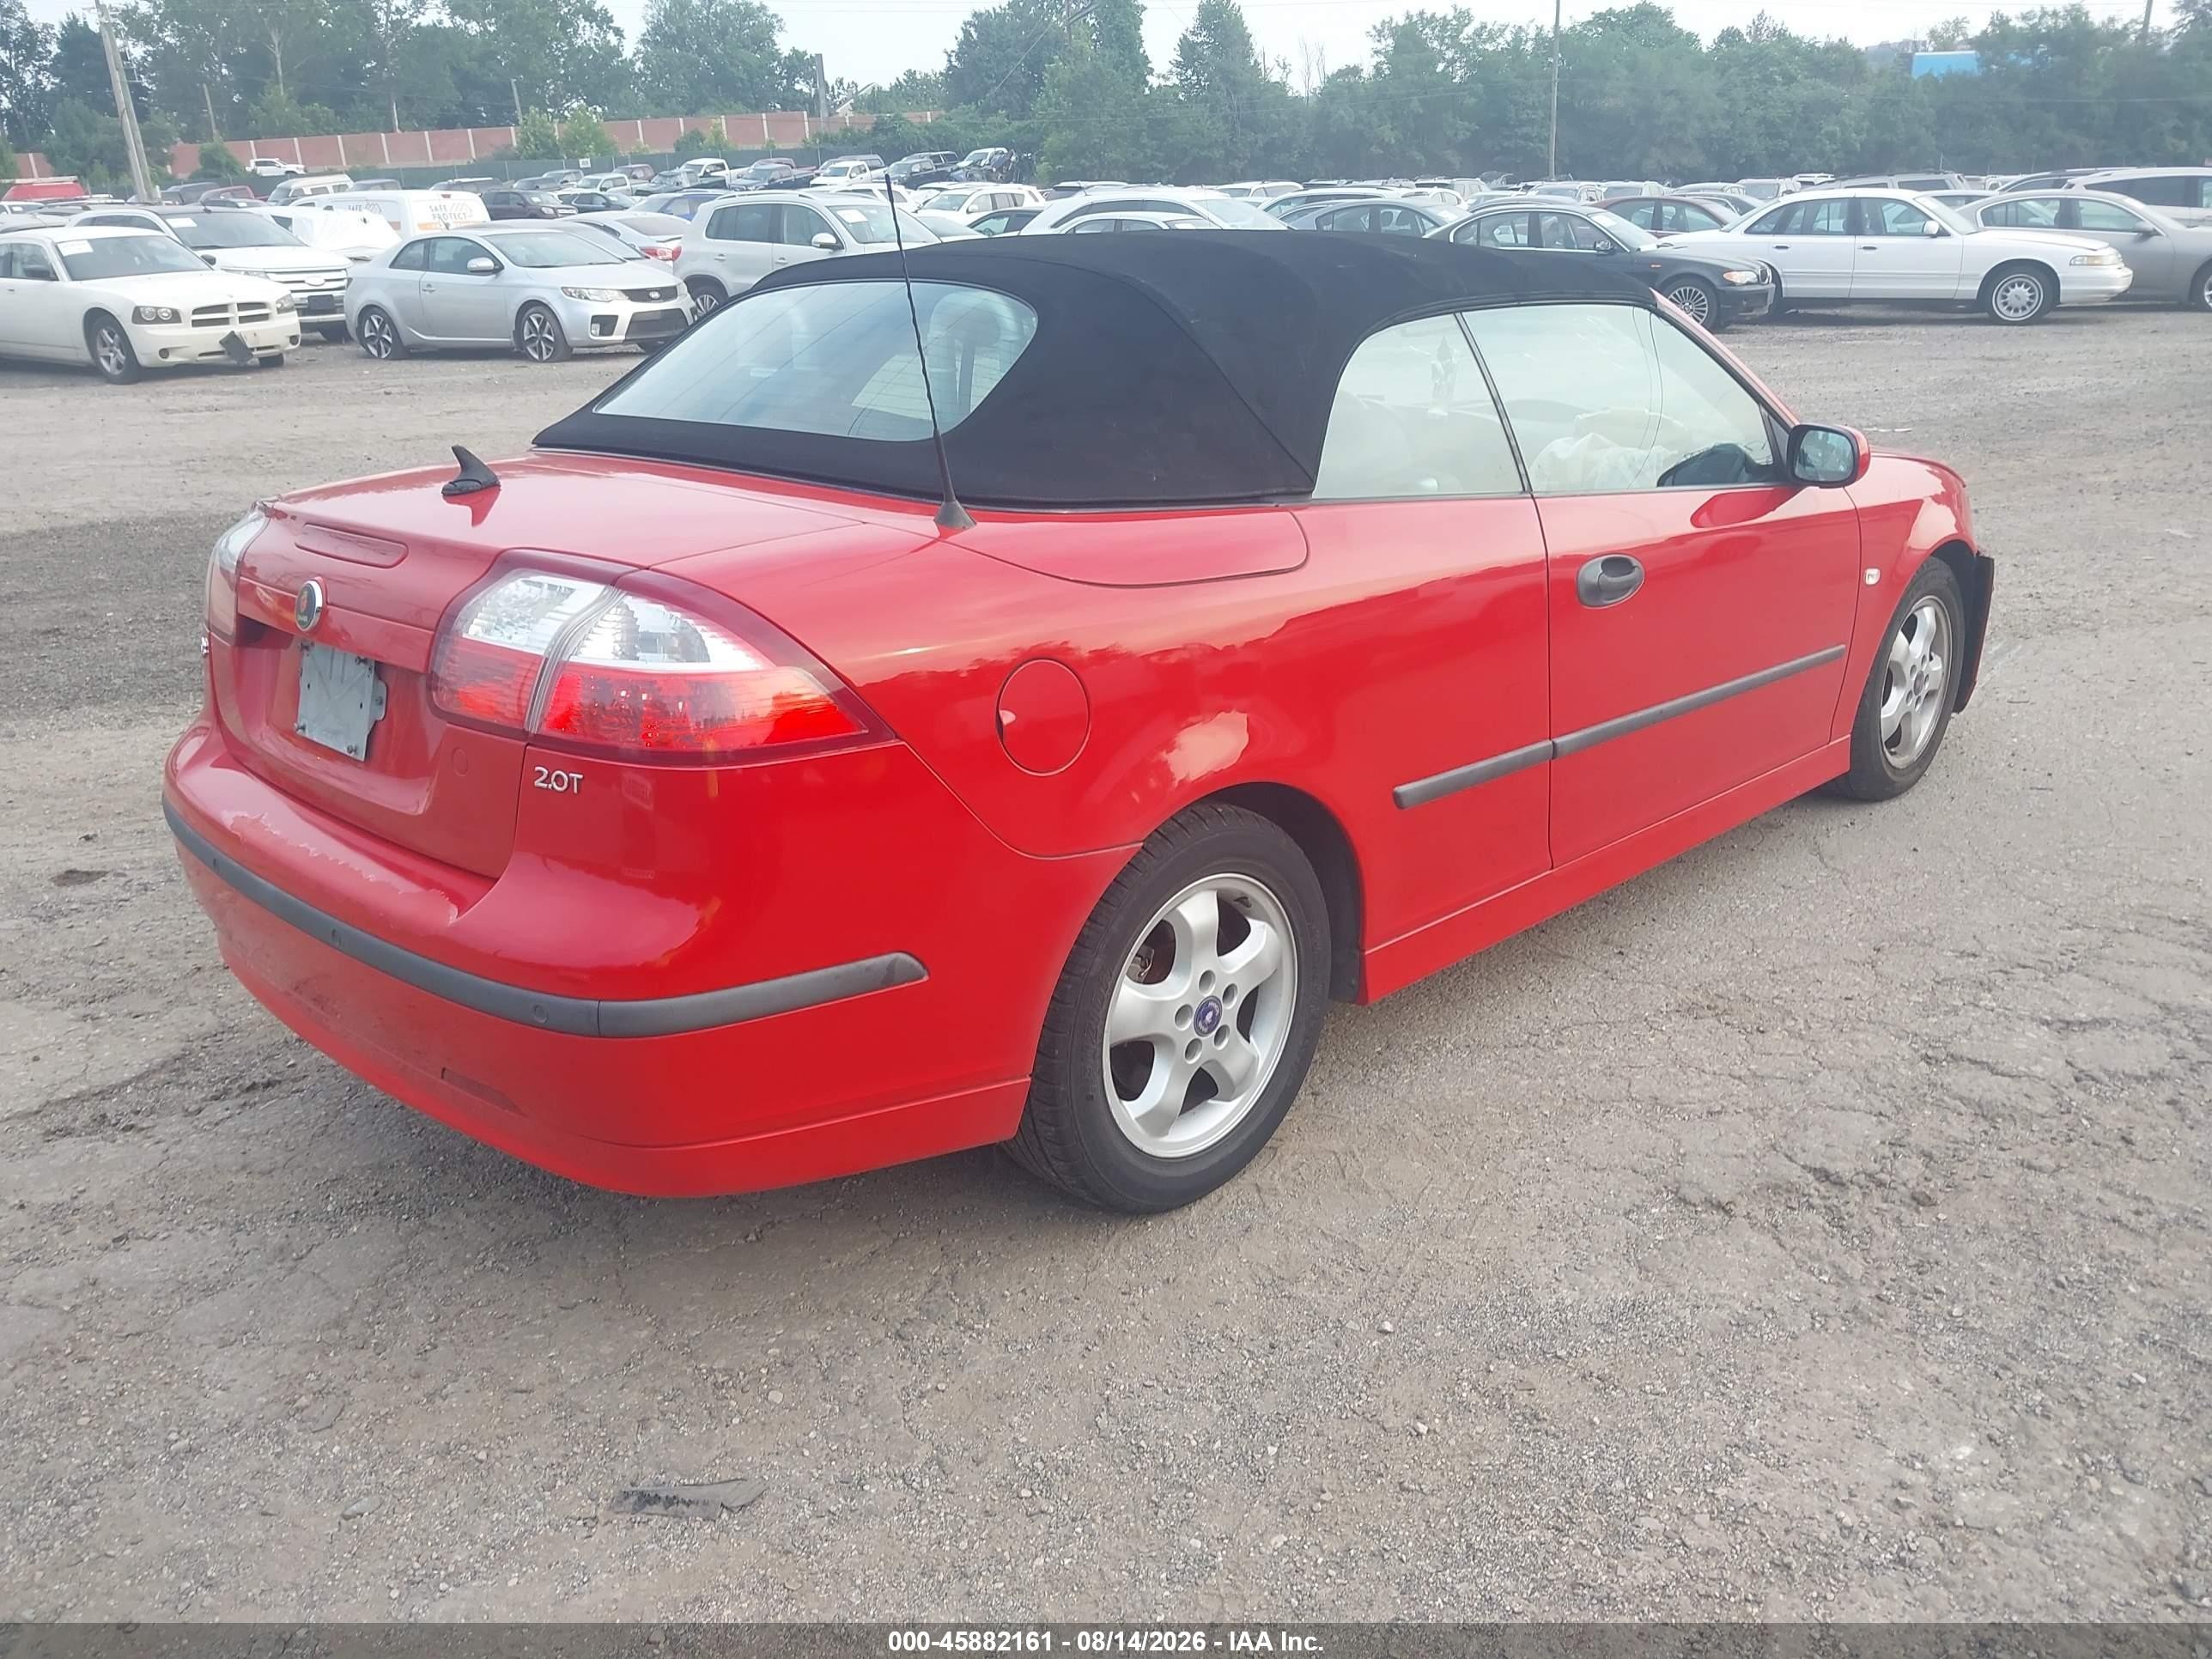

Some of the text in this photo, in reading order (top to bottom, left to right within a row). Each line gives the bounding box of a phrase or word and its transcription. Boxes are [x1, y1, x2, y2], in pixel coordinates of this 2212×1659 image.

[428, 204, 448, 213] SAFE
[432, 211, 468, 222] PROTECT
[534, 765, 584, 794] 2.0T
